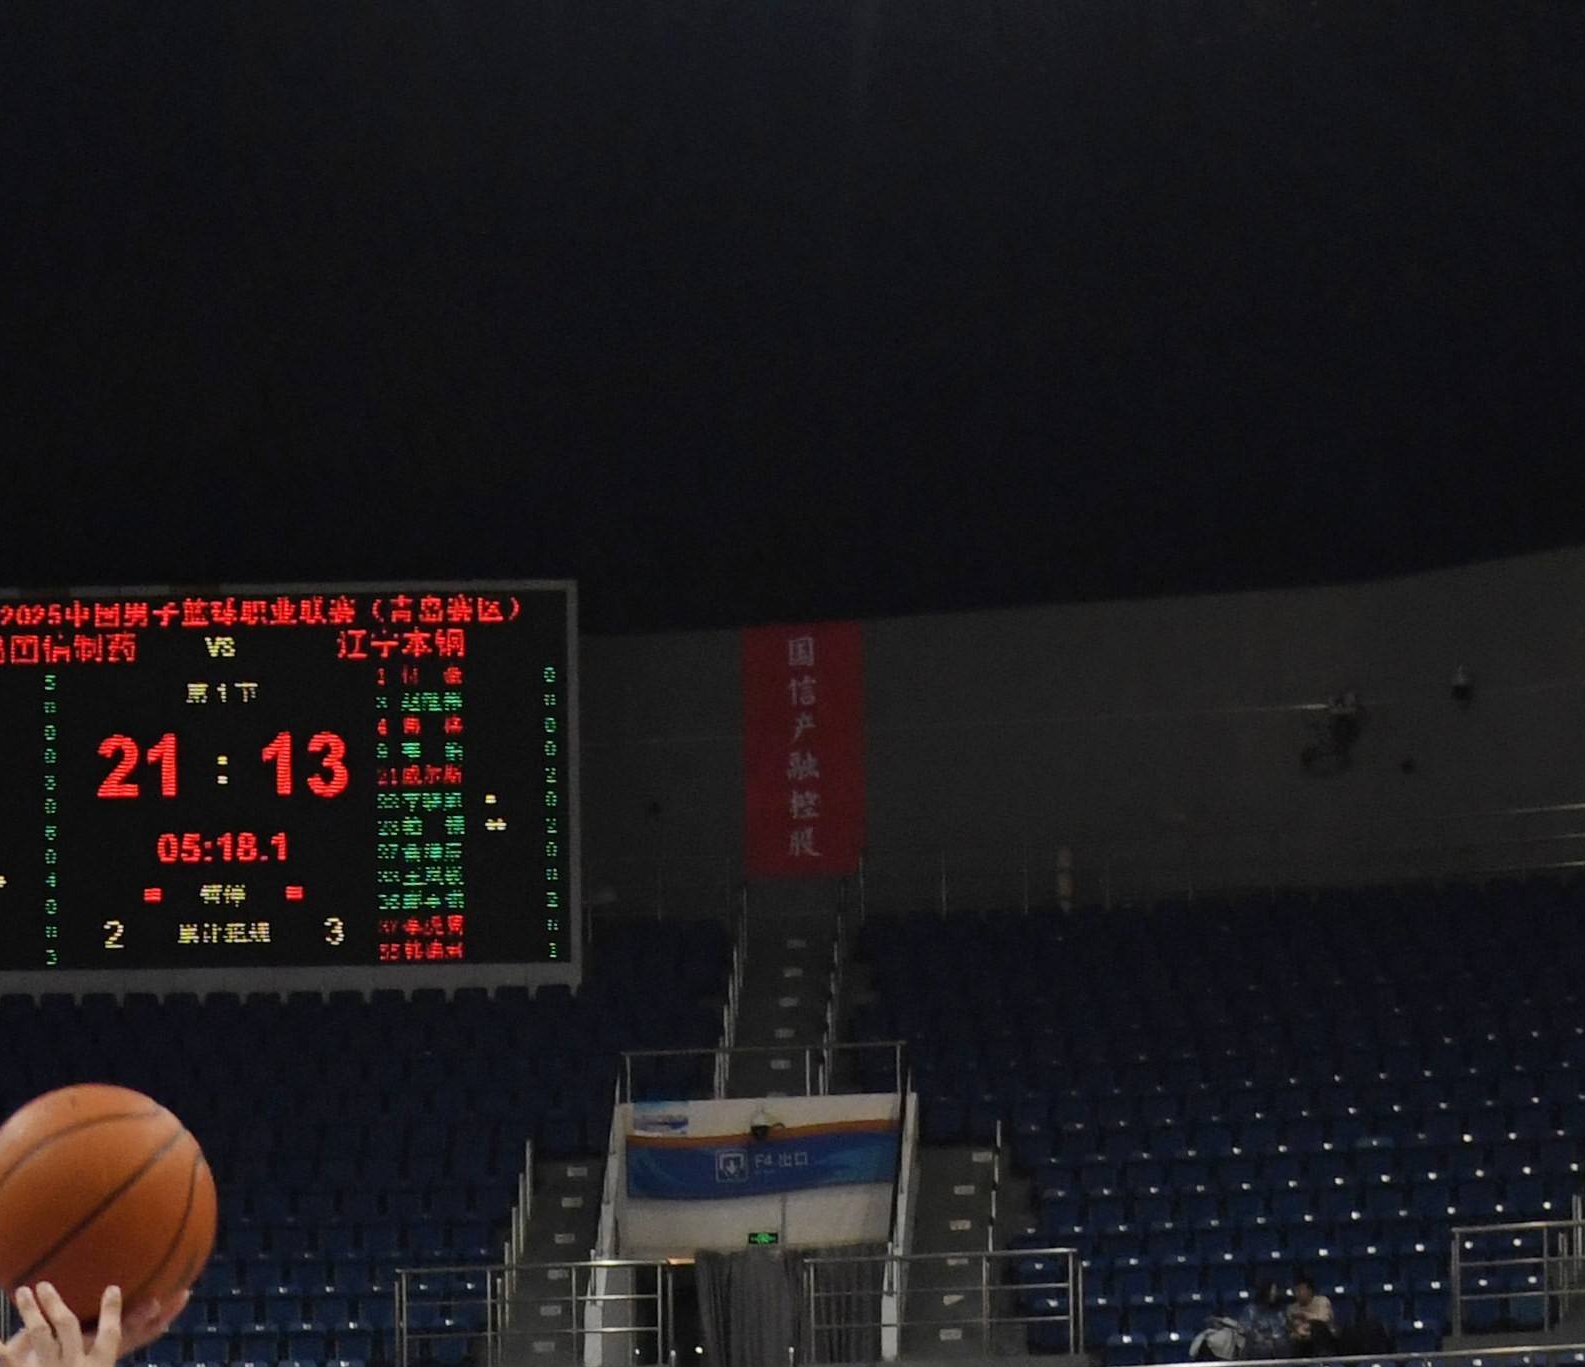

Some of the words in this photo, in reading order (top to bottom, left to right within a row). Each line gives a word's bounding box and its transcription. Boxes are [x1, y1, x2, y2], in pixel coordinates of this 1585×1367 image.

[204, 637, 236, 658] VS
[97, 732, 178, 798] 21
[262, 731, 348, 798] 13
[157, 831, 288, 864] 05:18.1
[103, 919, 126, 949] 2
[323, 916, 345, 946] 3
